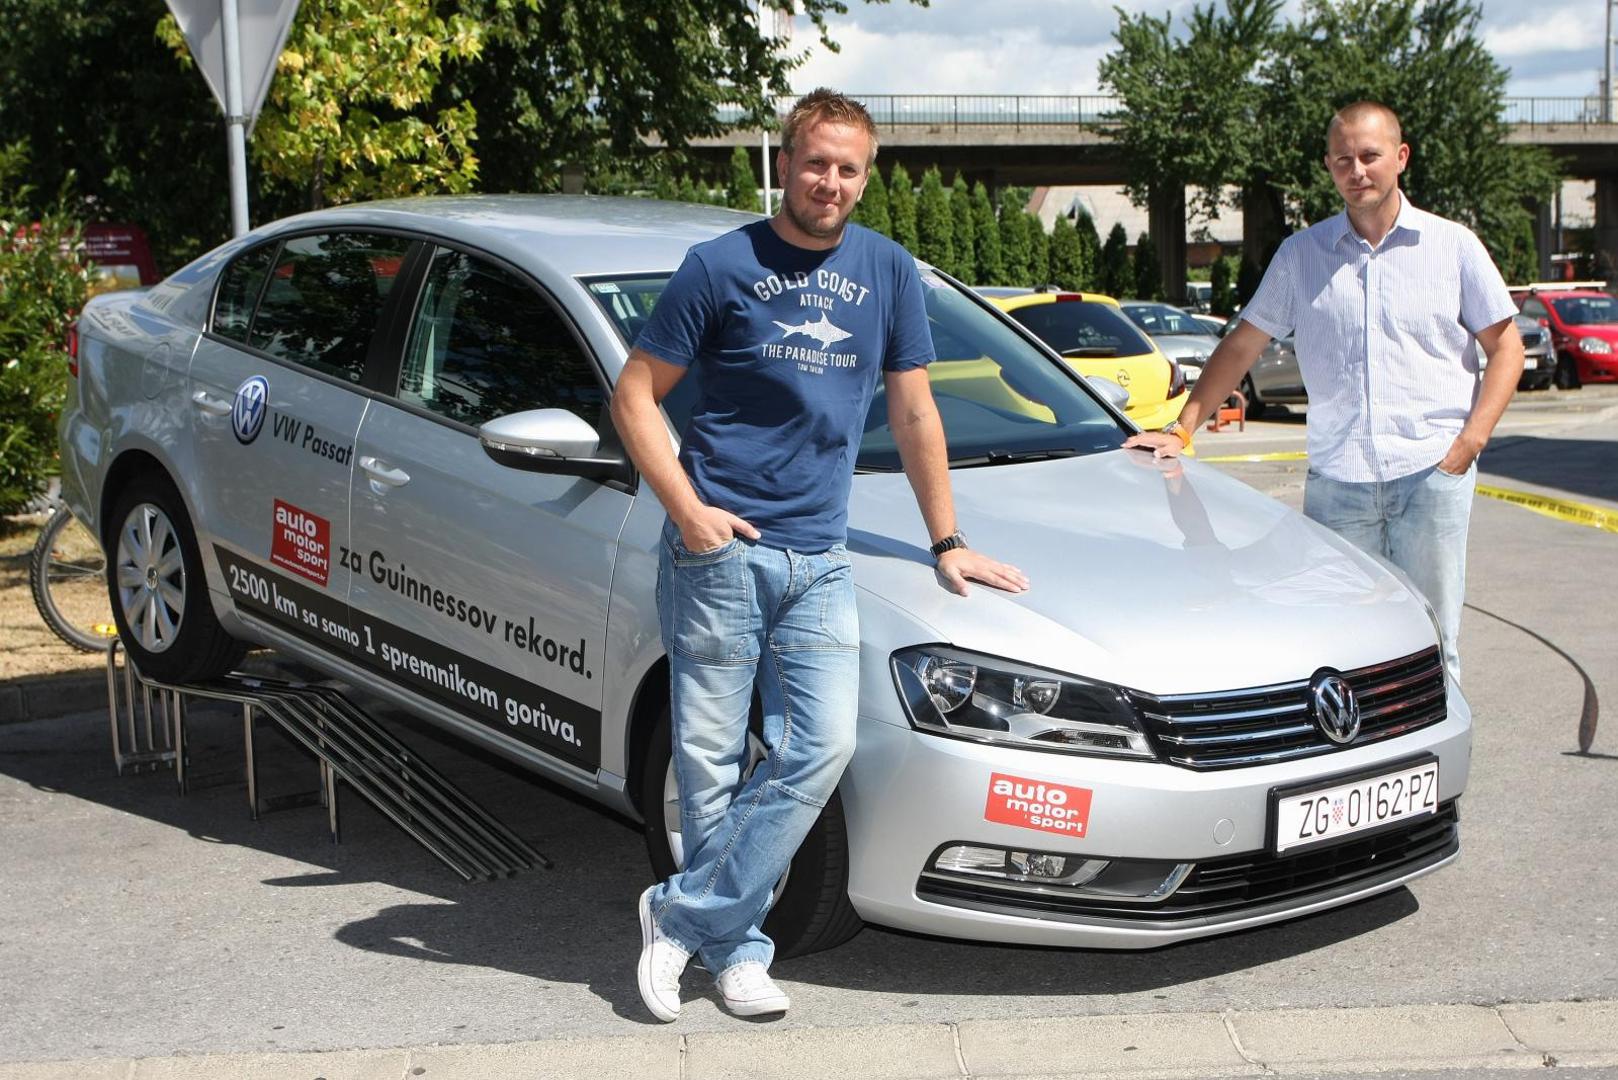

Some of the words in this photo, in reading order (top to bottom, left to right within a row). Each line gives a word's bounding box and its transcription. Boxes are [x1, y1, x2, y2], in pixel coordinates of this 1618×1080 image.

[753, 271, 809, 301] GOLD
[817, 269, 870, 306] COAST
[800, 293, 834, 311] ATTACK
[762, 344, 784, 359] THE
[785, 346, 828, 366] PARADISE
[830, 353, 857, 368] TOUR
[273, 413, 302, 444] VW
[302, 424, 353, 466] Passat
[276, 506, 317, 538] auto
[283, 528, 325, 554] motor
[297, 548, 328, 571] sport
[339, 546, 362, 574] za
[369, 550, 498, 634] Guinnessov
[504, 616, 592, 680] rekord.
[229, 564, 269, 605] 2500
[272, 582, 299, 619] km
[302, 608, 319, 629] sa
[321, 617, 360, 648] samo
[363, 625, 376, 655] 1
[381, 642, 499, 711] spremnikom
[505, 697, 582, 747] goriva.
[993, 779, 1068, 806] auto
[1006, 798, 1079, 820] motor
[1299, 796, 1330, 839] ZG
[1030, 814, 1083, 833] sport
